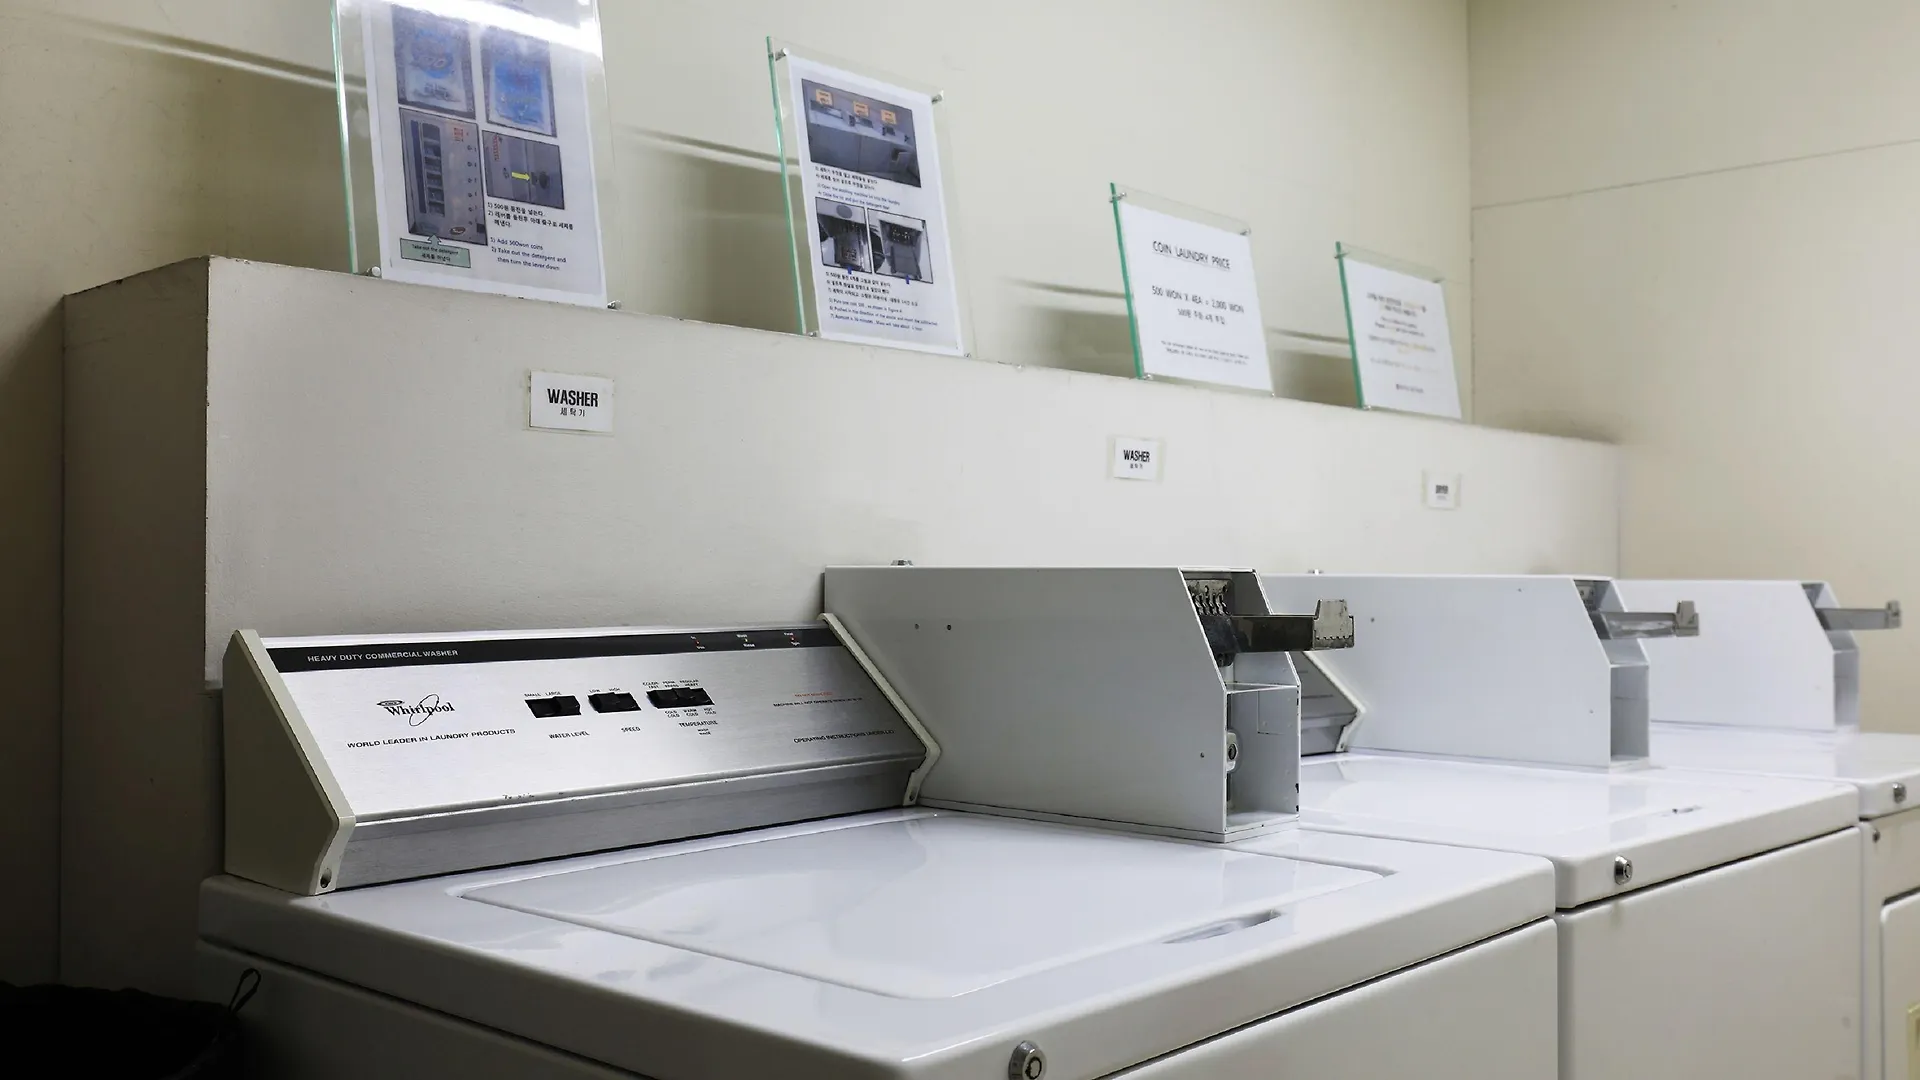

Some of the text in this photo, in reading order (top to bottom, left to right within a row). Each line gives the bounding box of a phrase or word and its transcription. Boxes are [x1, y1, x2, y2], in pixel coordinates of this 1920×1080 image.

[497, 247, 510, 255] Take
[531, 253, 556, 262] detergent
[1153, 240, 1231, 270] COIN LAUNDRY PRICE
[1152, 285, 1164, 296] 500
[1165, 288, 1182, 300] WON
[1228, 302, 1245, 314] WON
[547, 388, 599, 408] WASHER
[1123, 449, 1151, 463] WASHER
[365, 651, 423, 660] COMMERCIAL
[423, 649, 459, 657] WASHER
[383, 701, 456, 716] Whirlpool
[347, 740, 381, 749] WORLD
[382, 737, 418, 746] LEADER
[430, 732, 469, 741] LAUNDRY
[471, 729, 516, 738] PRODUCTS
[548, 731, 571, 739] WATER
[793, 734, 826, 743] OPERATING
[826, 731, 866, 740] INSTRUCTIONS
